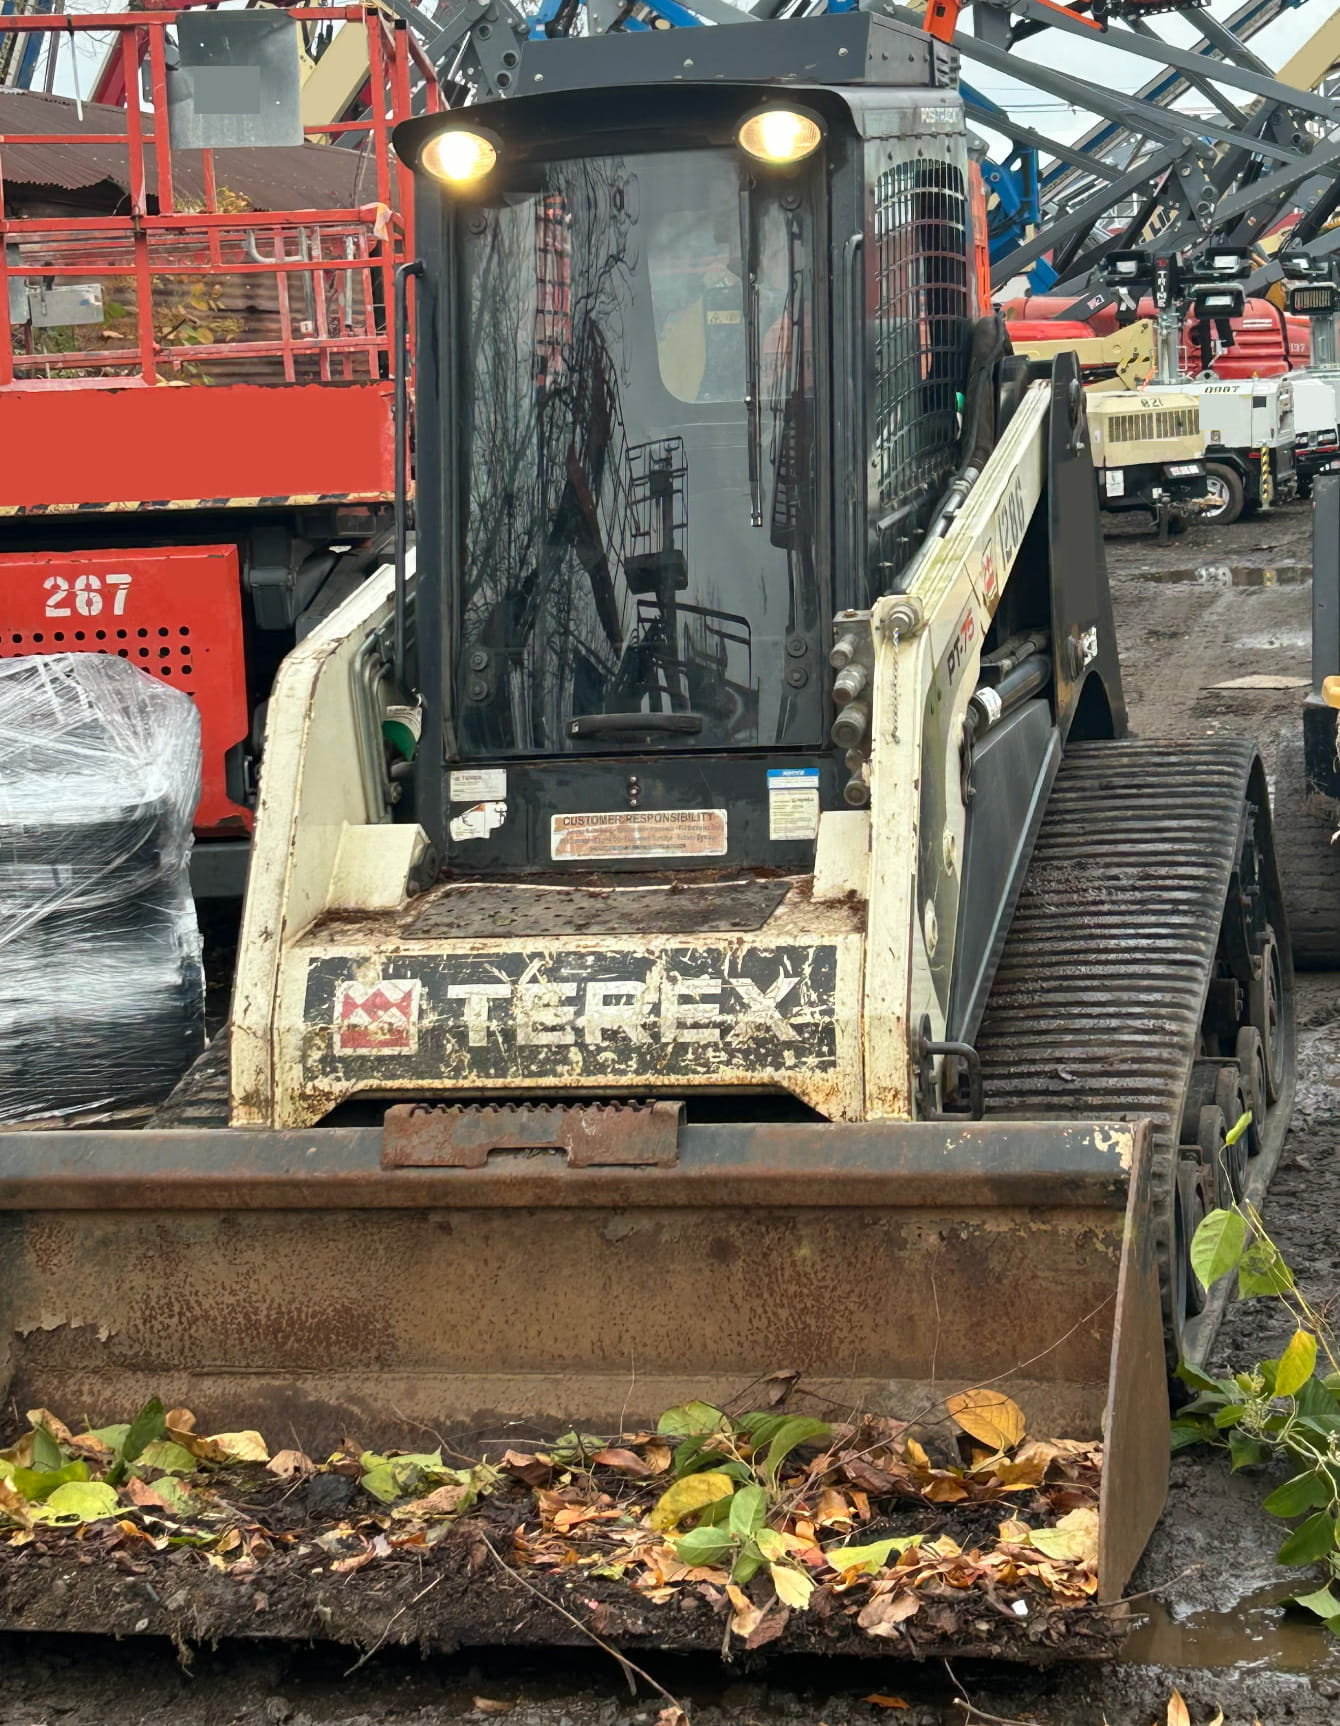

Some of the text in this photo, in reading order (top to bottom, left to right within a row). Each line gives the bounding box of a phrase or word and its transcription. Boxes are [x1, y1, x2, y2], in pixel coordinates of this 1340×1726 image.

[43, 573, 133, 618] 267
[563, 811, 714, 826] CUSTOMER RESPONSIBILITY
[446, 976, 803, 1047] TEREX
